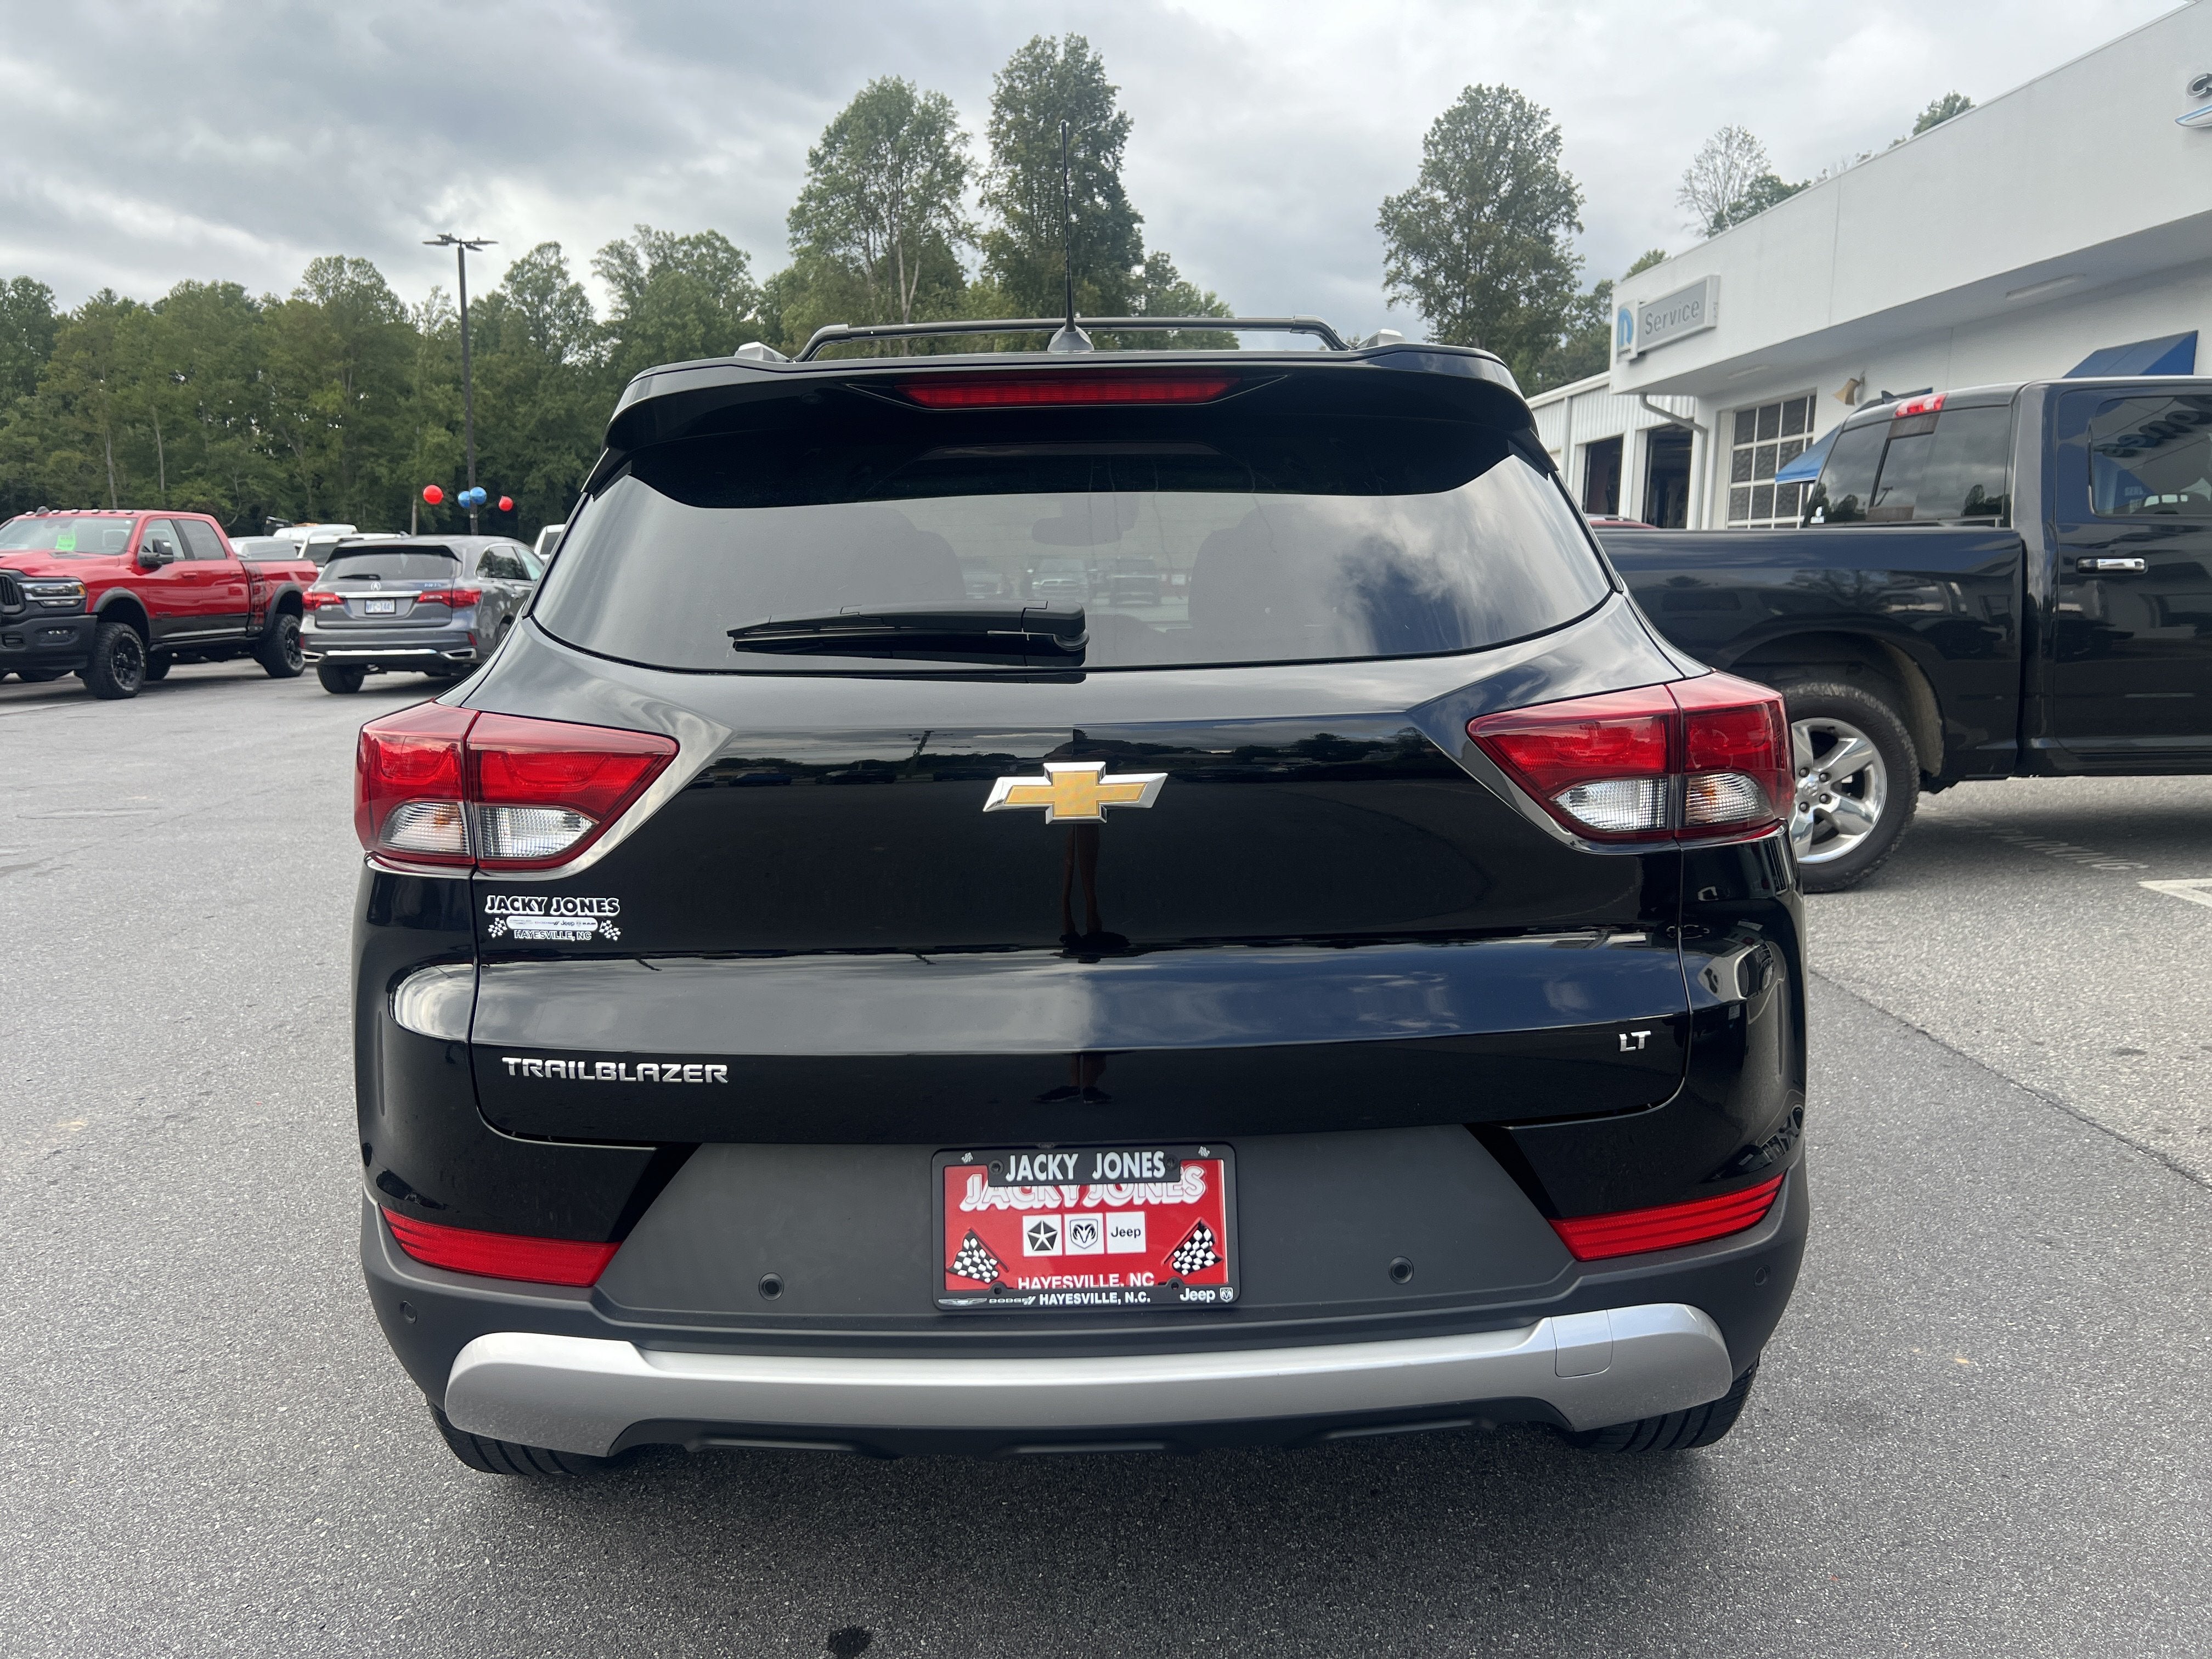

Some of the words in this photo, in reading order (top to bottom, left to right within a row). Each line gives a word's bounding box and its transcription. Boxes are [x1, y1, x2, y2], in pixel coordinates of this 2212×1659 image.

[1645, 300, 1700, 335] Service
[485, 895, 548, 915] JACKY
[550, 897, 620, 916] JONES
[514, 930, 575, 941] HAYESVILLE,
[577, 931, 592, 940] NC
[1619, 1030, 1651, 1052] LT
[501, 1057, 729, 1084] TRAILBLAZER
[1006, 1153, 1079, 1182] JACKY
[1092, 1150, 1165, 1180] JONES
[1110, 1226, 1141, 1241] Jeep
[1129, 1272, 1155, 1287] NC
[1040, 1291, 1121, 1305] HAYESVILLE,
[1125, 1290, 1150, 1303] N.C.
[1180, 1288, 1216, 1304] Jeep
